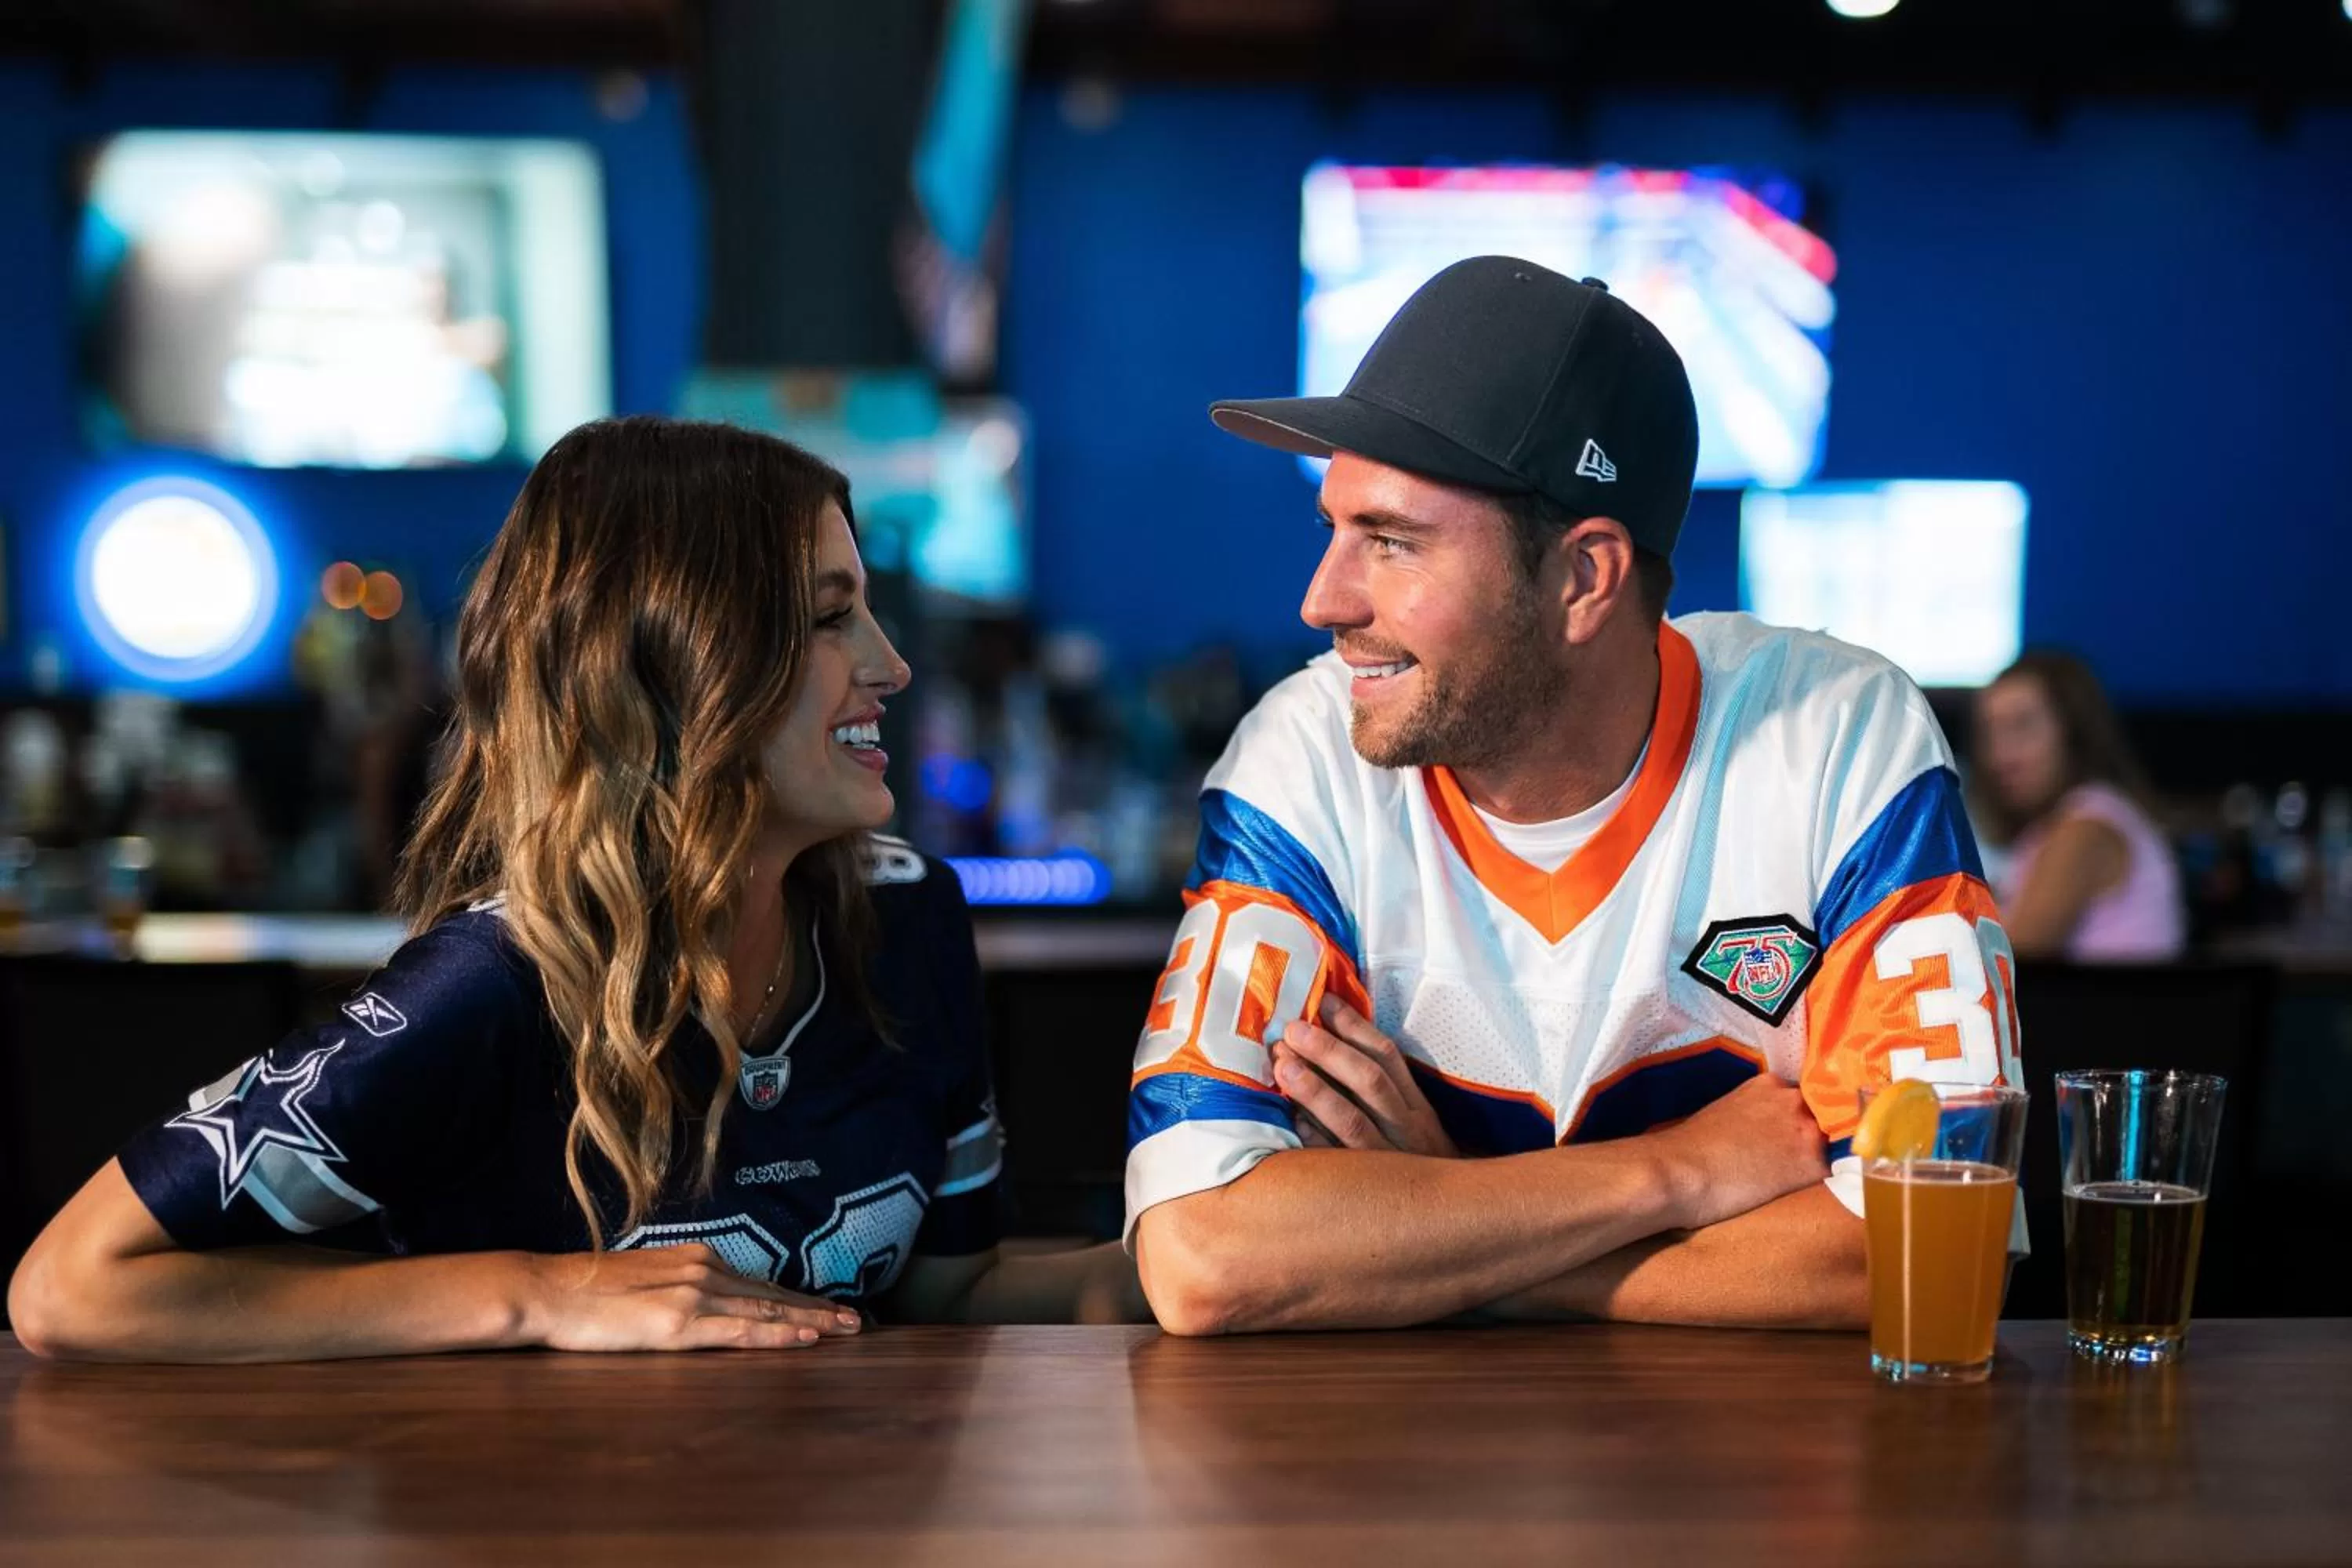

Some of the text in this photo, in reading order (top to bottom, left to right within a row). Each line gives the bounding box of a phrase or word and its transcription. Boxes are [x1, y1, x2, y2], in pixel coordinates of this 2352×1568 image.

[1133, 898, 1325, 1087] 30
[1716, 931, 1798, 1001] 75
[1873, 912, 2025, 1098] 30
